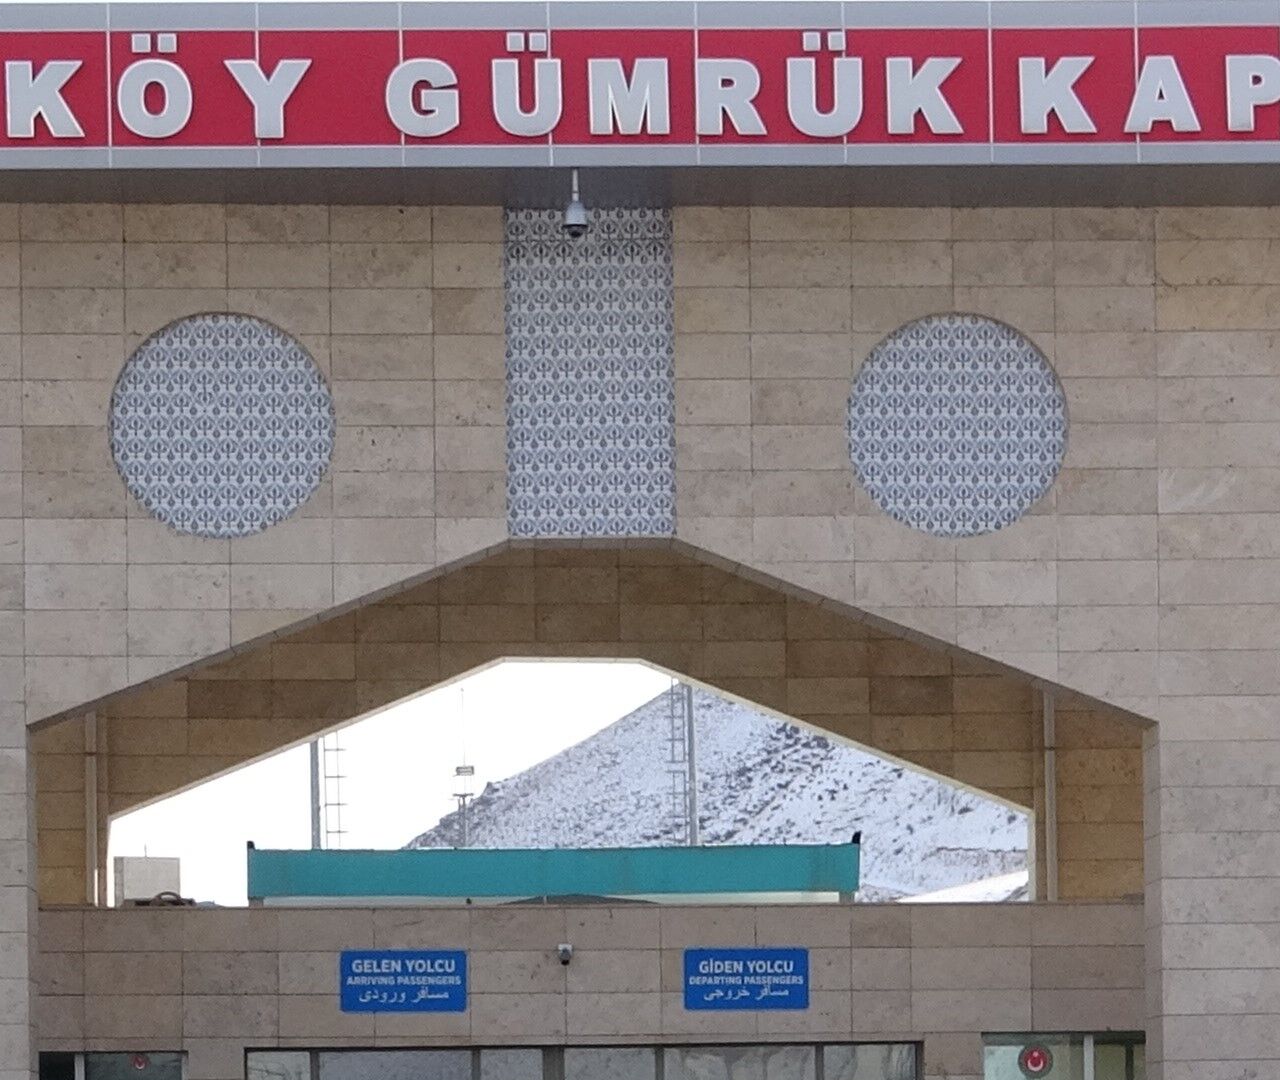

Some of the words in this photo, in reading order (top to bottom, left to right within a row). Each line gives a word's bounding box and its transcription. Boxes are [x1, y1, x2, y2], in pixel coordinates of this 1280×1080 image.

[384, 31, 965, 138] GÜMRÜK
[351, 959, 402, 973] GELEN
[404, 959, 456, 973] YOLCU
[698, 957, 744, 974] GİDEN
[746, 960, 795, 974] YOLCU
[346, 975, 396, 986] ARRIVING
[396, 975, 462, 986] PASSENGERS
[688, 975, 742, 985] DEPARTING
[743, 975, 804, 985] PASSENGERS
[410, 986, 450, 1003] مسافر
[754, 984, 790, 1001] مسافر
